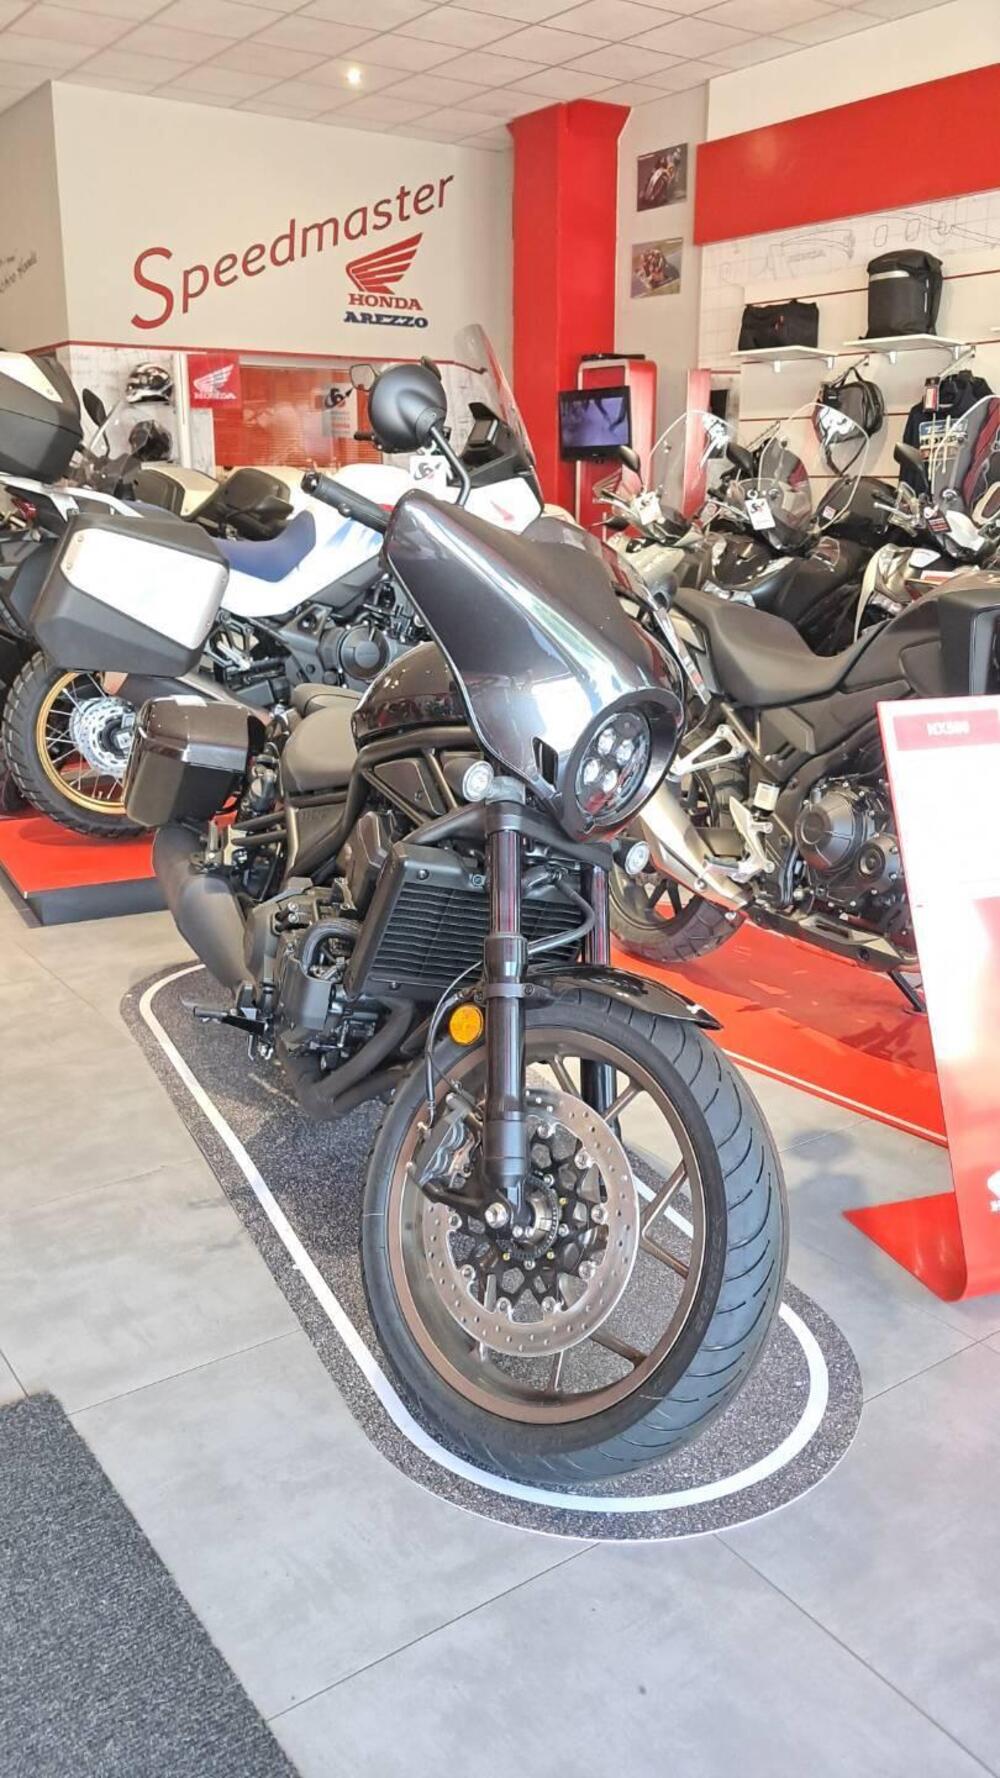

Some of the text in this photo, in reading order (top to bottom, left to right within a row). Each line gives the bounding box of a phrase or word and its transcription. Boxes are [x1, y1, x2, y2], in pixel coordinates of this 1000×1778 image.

[131, 175, 454, 329] Speedmaster
[348, 293, 423, 310] HONDA
[344, 311, 429, 328] AREZZO
